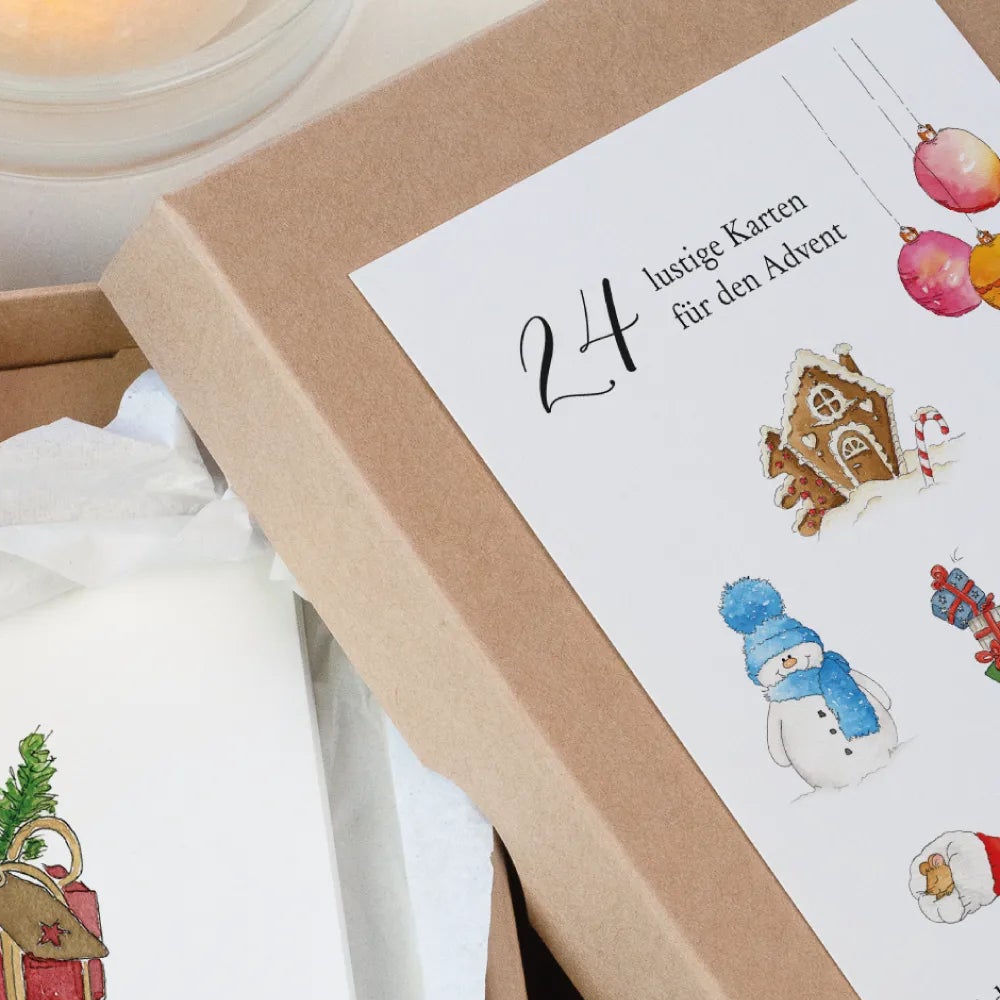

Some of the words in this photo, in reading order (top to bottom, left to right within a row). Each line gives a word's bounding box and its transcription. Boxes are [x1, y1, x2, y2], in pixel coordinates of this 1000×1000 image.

[641, 240, 725, 292] lustige
[719, 195, 808, 248] Karten
[671, 298, 713, 331] für
[715, 274, 763, 306] den
[763, 224, 848, 281] Advent
[519, 277, 639, 414] 24
